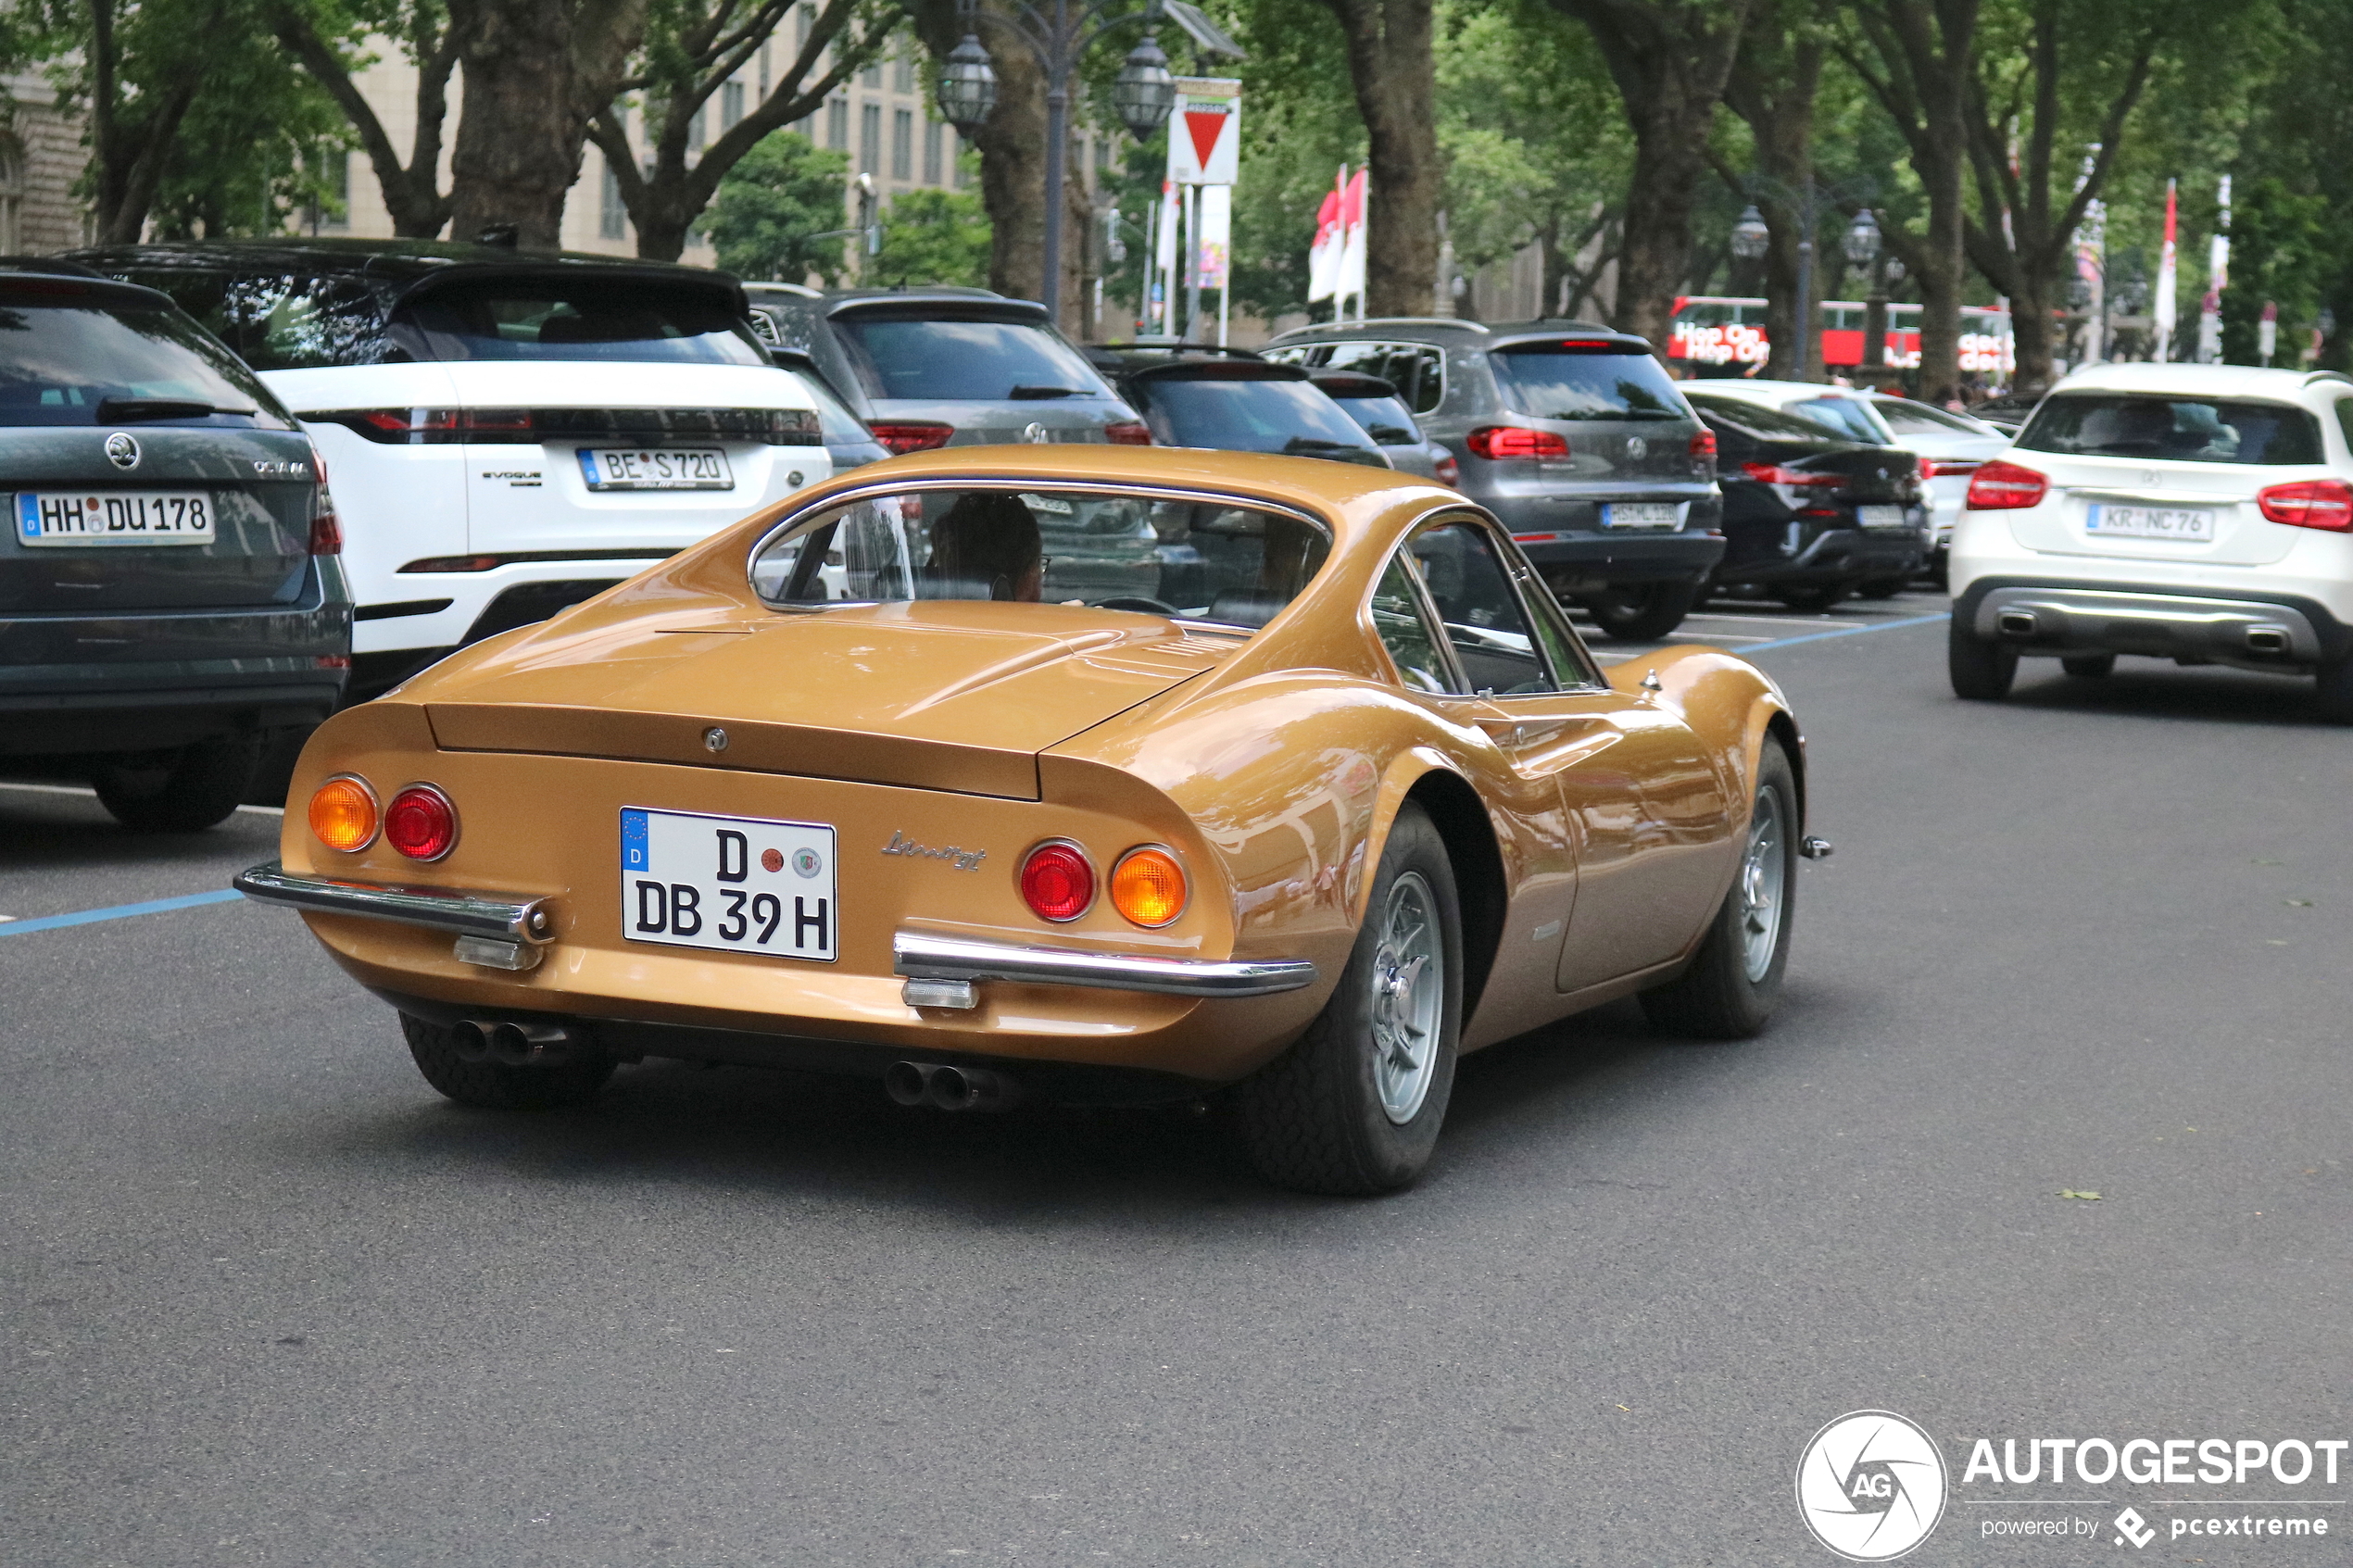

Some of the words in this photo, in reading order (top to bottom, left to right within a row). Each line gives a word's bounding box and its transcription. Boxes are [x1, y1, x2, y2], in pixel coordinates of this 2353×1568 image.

[1675, 321, 1723, 345] Hop
[1725, 323, 1760, 345] On
[1686, 340, 1733, 365] Hop
[605, 453, 642, 479] BE
[655, 453, 673, 478] S
[673, 453, 721, 478] 720
[27, 520, 35, 532] D
[41, 498, 85, 533] HH
[105, 497, 146, 531] DU
[152, 497, 207, 531] 178
[2107, 508, 2133, 527] KR
[2146, 510, 2172, 530] NC
[2178, 512, 2202, 532] 76
[630, 848, 641, 864] D
[716, 828, 749, 883] D
[635, 880, 702, 936] DB
[718, 888, 782, 944] 39
[795, 896, 827, 950] H
